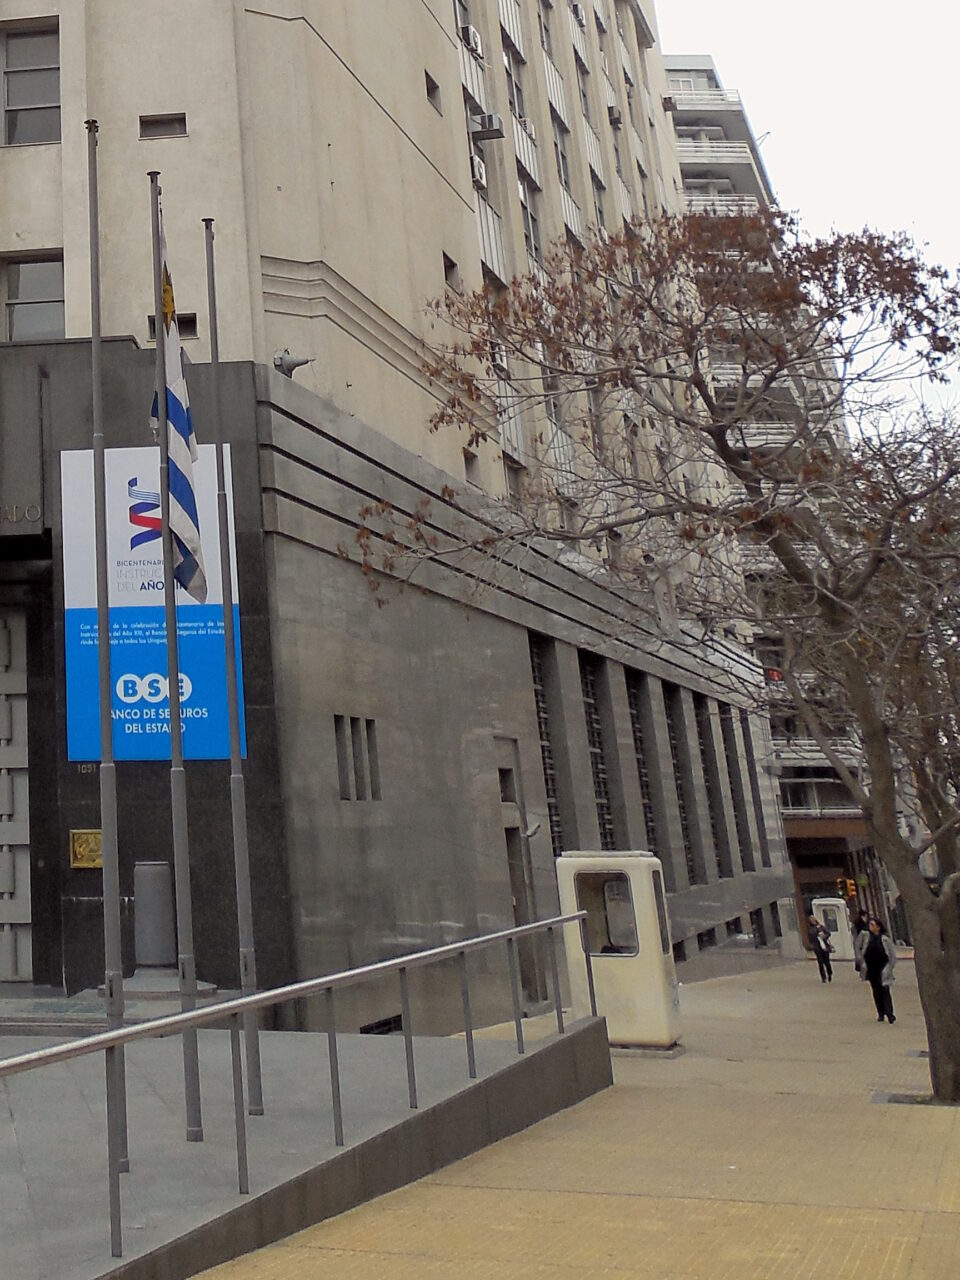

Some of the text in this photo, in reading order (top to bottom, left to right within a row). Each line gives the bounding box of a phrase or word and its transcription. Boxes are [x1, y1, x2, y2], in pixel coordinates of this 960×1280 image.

[116, 559, 165, 567] BICENTENARI
[139, 579, 165, 591] AÑO
[111, 708, 208, 719] ANCO DE SEUROS
[125, 723, 143, 733] DEL
